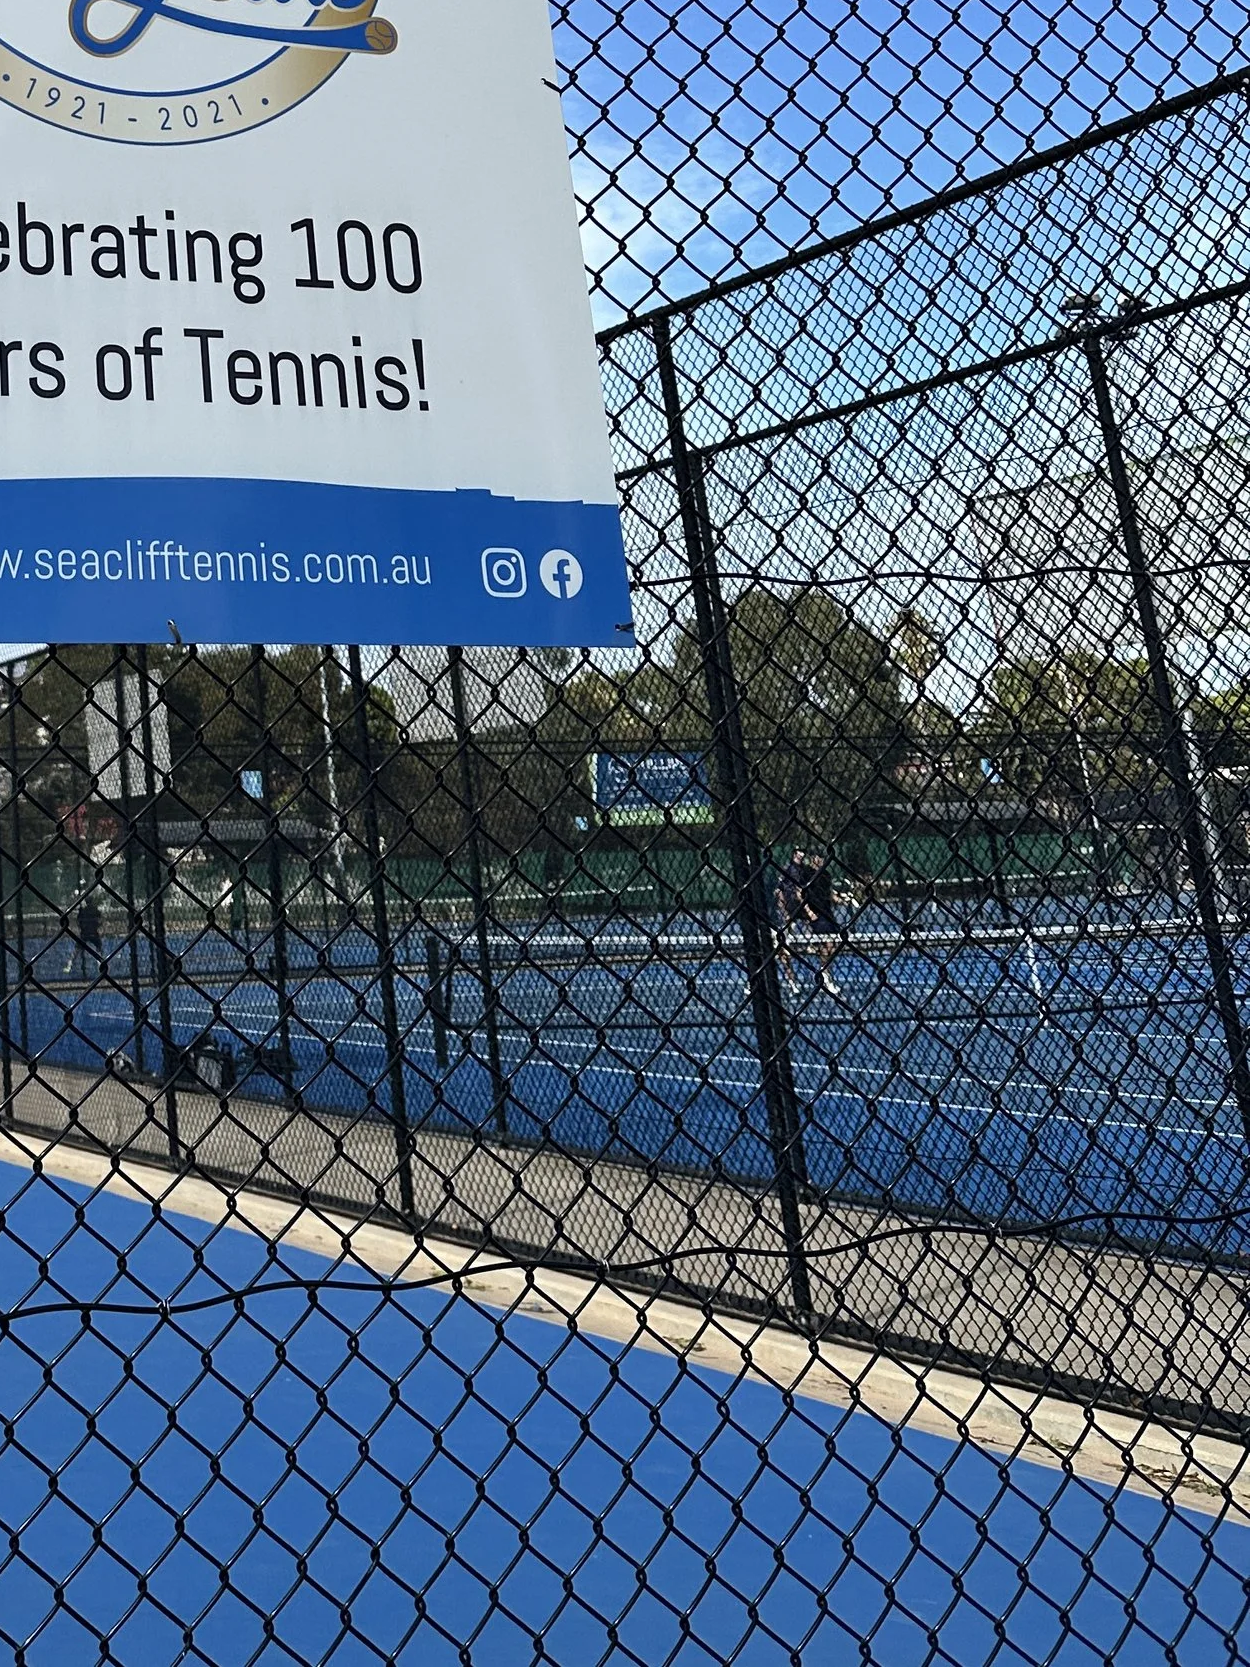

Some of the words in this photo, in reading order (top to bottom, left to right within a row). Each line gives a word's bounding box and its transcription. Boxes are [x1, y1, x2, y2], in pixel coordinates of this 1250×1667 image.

[22, 76, 107, 126] 1921
[158, 94, 245, 132] 2021
[290, 217, 424, 295] 100
[95, 326, 164, 402] of
[183, 328, 431, 413] Tennis!
